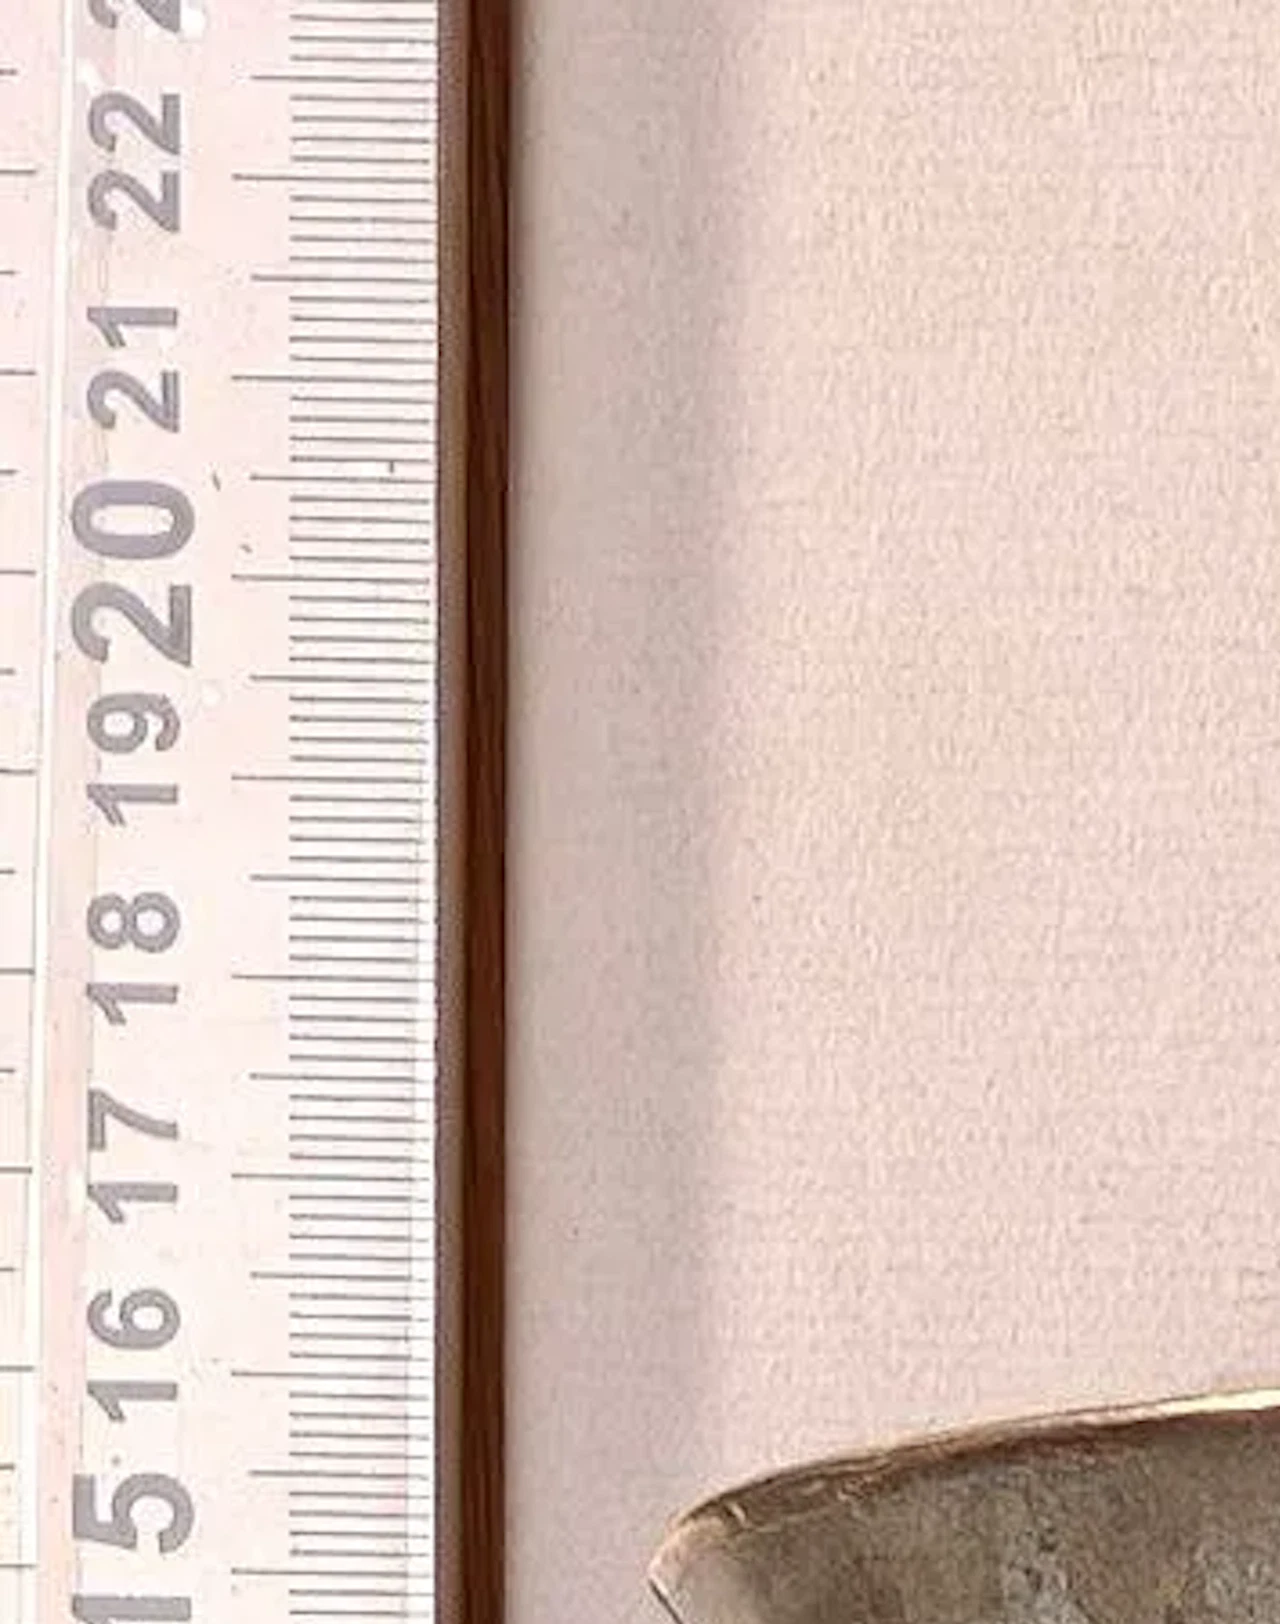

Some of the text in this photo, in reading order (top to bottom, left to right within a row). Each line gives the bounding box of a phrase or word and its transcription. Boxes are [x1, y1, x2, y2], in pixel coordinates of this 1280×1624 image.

[87, 92, 181, 234] 22
[86, 306, 180, 433] 21
[70, 481, 194, 668] 20
[86, 693, 180, 826] 19
[85, 892, 180, 1025] 18
[86, 1088, 179, 1224] 17
[86, 1289, 180, 1423] 16
